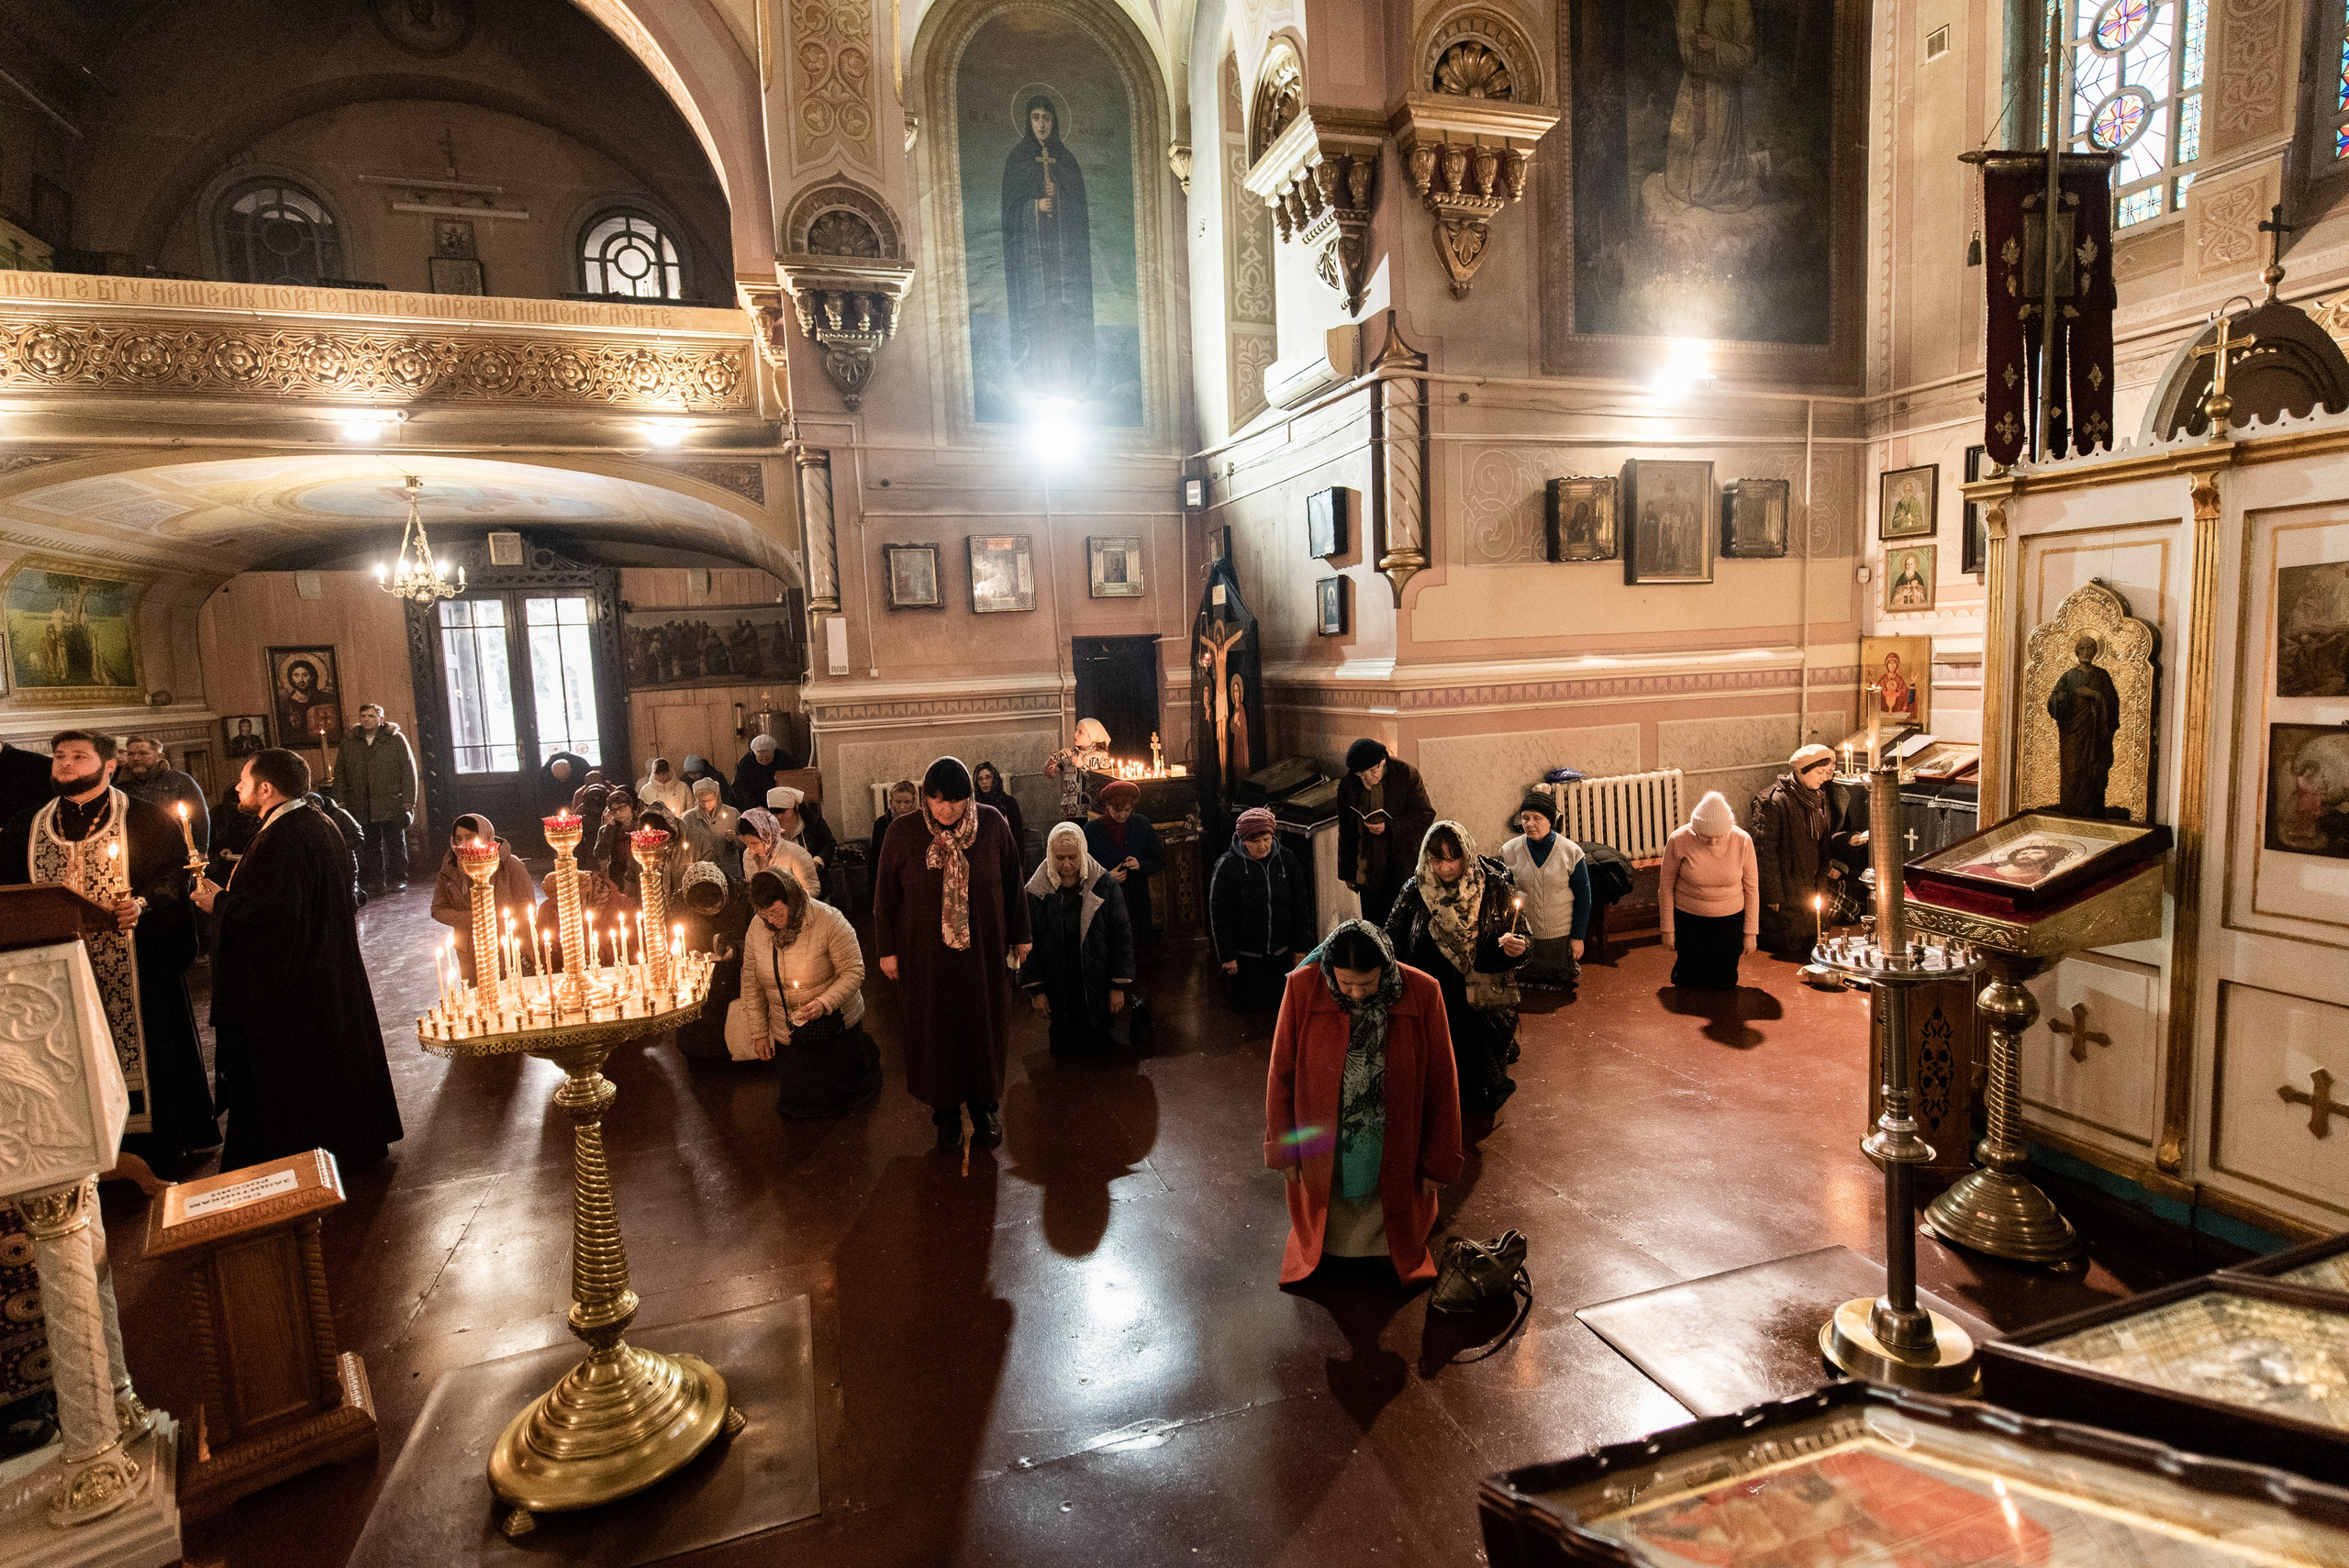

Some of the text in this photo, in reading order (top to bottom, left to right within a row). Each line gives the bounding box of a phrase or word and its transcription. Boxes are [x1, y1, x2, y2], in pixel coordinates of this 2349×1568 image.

[189, 1178, 291, 1208] ЗАЩИТНИКАМ
[211, 1178, 270, 1197] РОССИИ
[223, 1192, 262, 1206] СБОР
